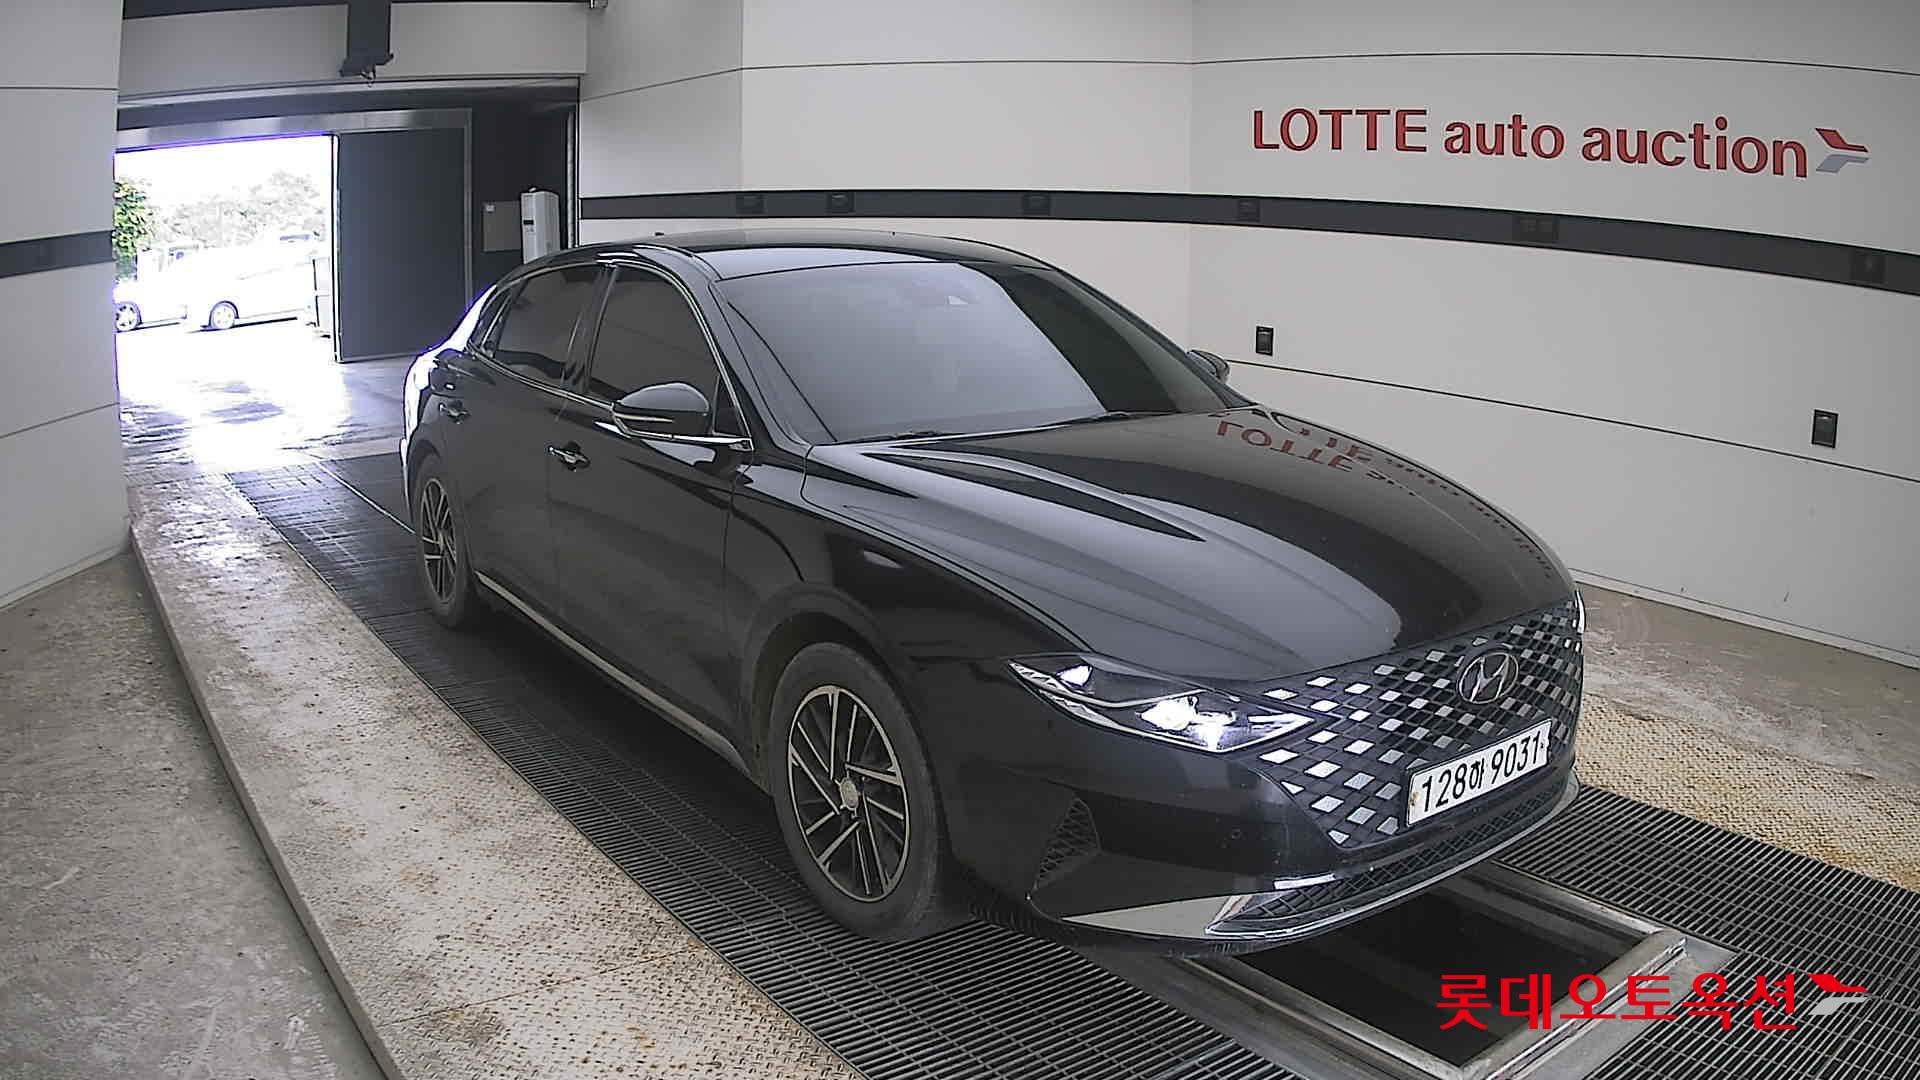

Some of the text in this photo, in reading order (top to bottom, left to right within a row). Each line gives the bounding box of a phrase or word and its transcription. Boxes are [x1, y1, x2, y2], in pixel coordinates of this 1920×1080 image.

[1253, 108, 1809, 179] LOTTE auto auction
[1491, 730, 1542, 785] 9031
